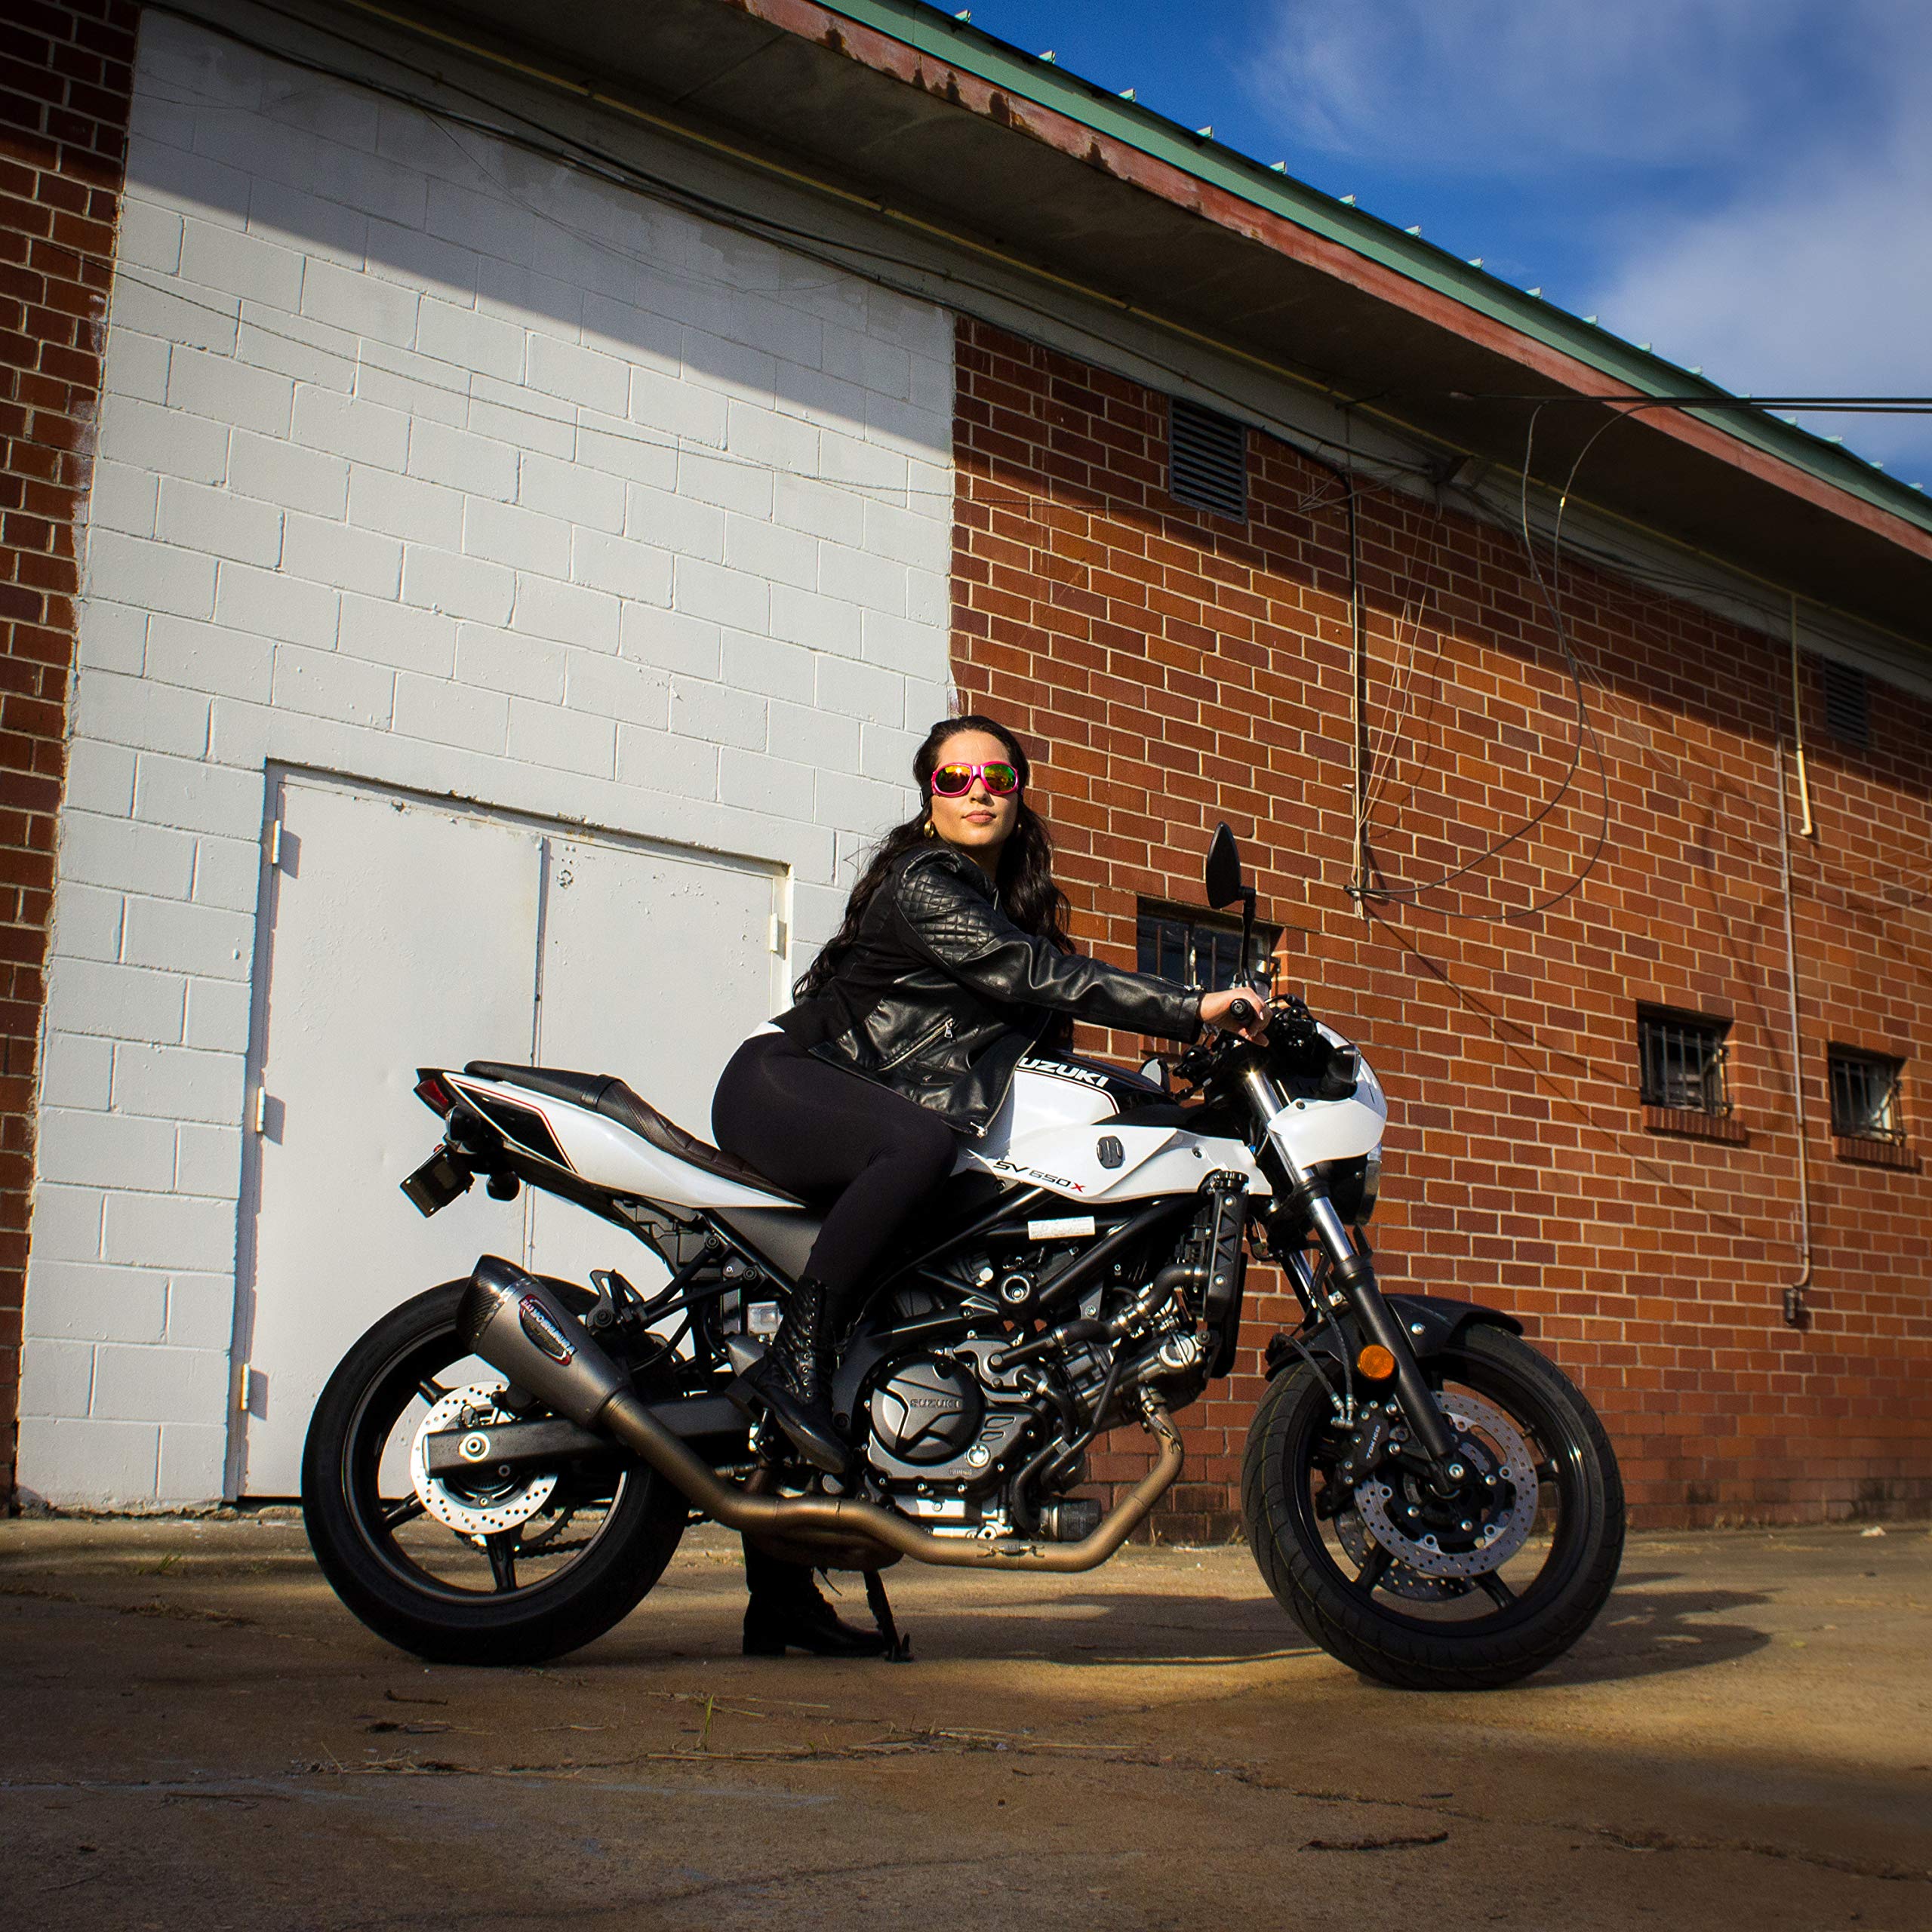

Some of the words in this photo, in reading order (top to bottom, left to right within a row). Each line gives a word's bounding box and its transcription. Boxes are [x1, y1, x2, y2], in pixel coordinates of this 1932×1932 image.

[1017, 1057, 1109, 1088] UZUKI
[910, 1398, 961, 1408] SUZUKI
[1366, 1425, 1380, 1460] TOKICO
